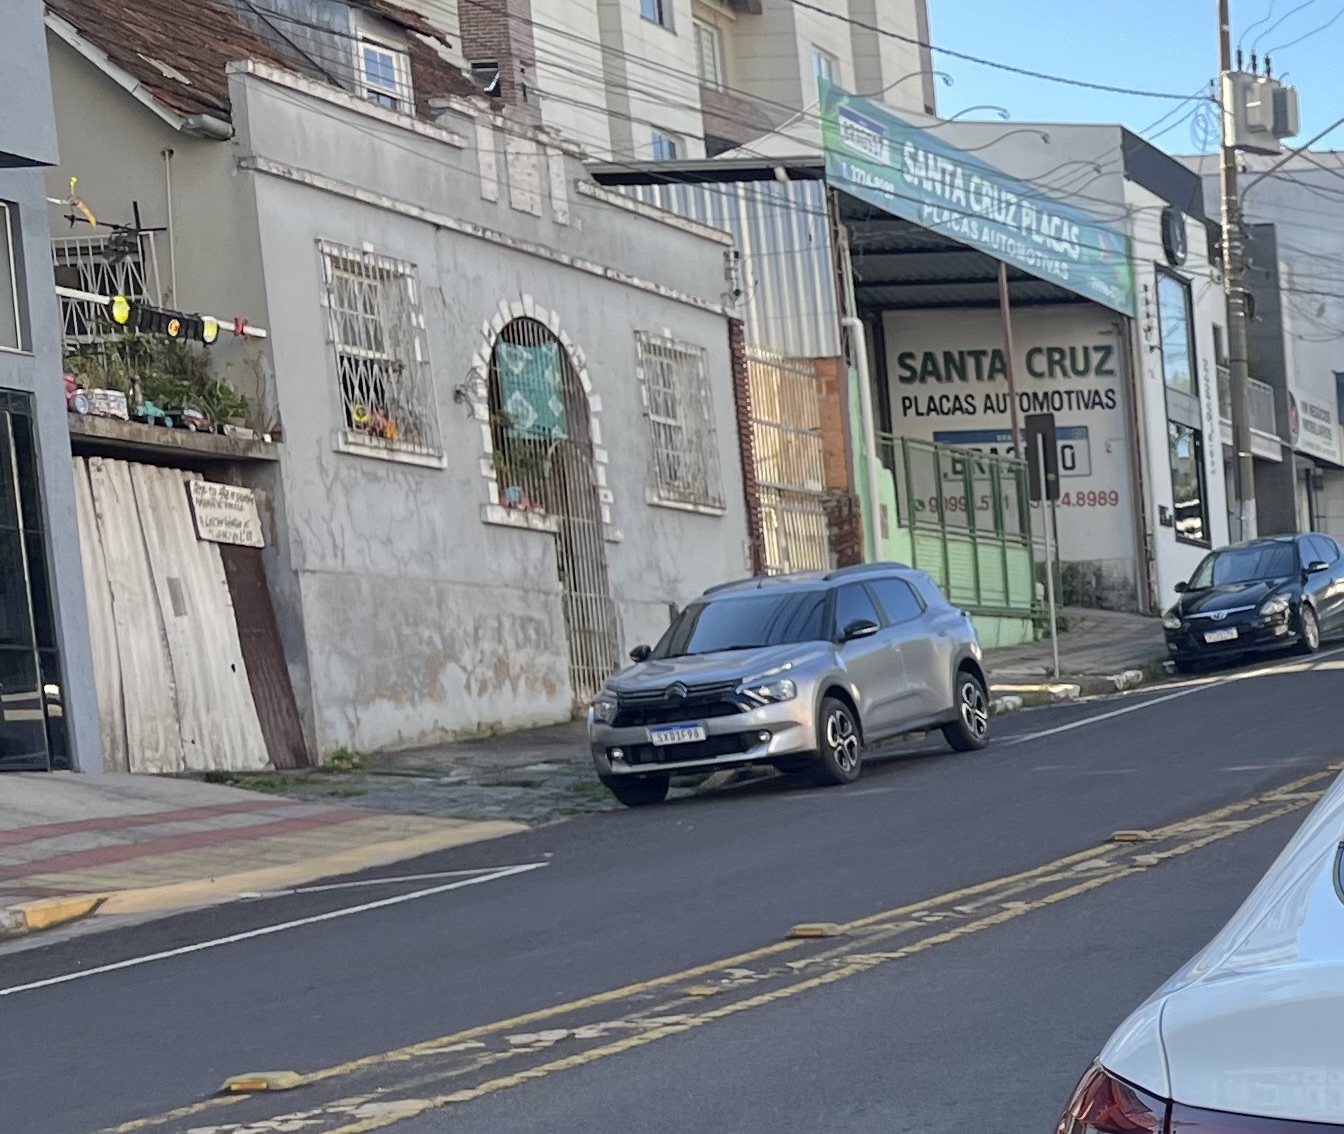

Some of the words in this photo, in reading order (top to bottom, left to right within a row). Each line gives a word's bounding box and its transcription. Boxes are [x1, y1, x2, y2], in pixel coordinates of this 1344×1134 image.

[903, 141, 967, 207] SANTA
[970, 175, 1018, 232] CRUZ
[1021, 200, 1081, 261] PLACAS
[923, 200, 979, 240] PLACAS
[981, 226, 1070, 280] AUTOMOTIVAS
[897, 349, 1008, 384] SANTA
[1025, 345, 1117, 379] CRUZ
[902, 393, 976, 416] PLACAS
